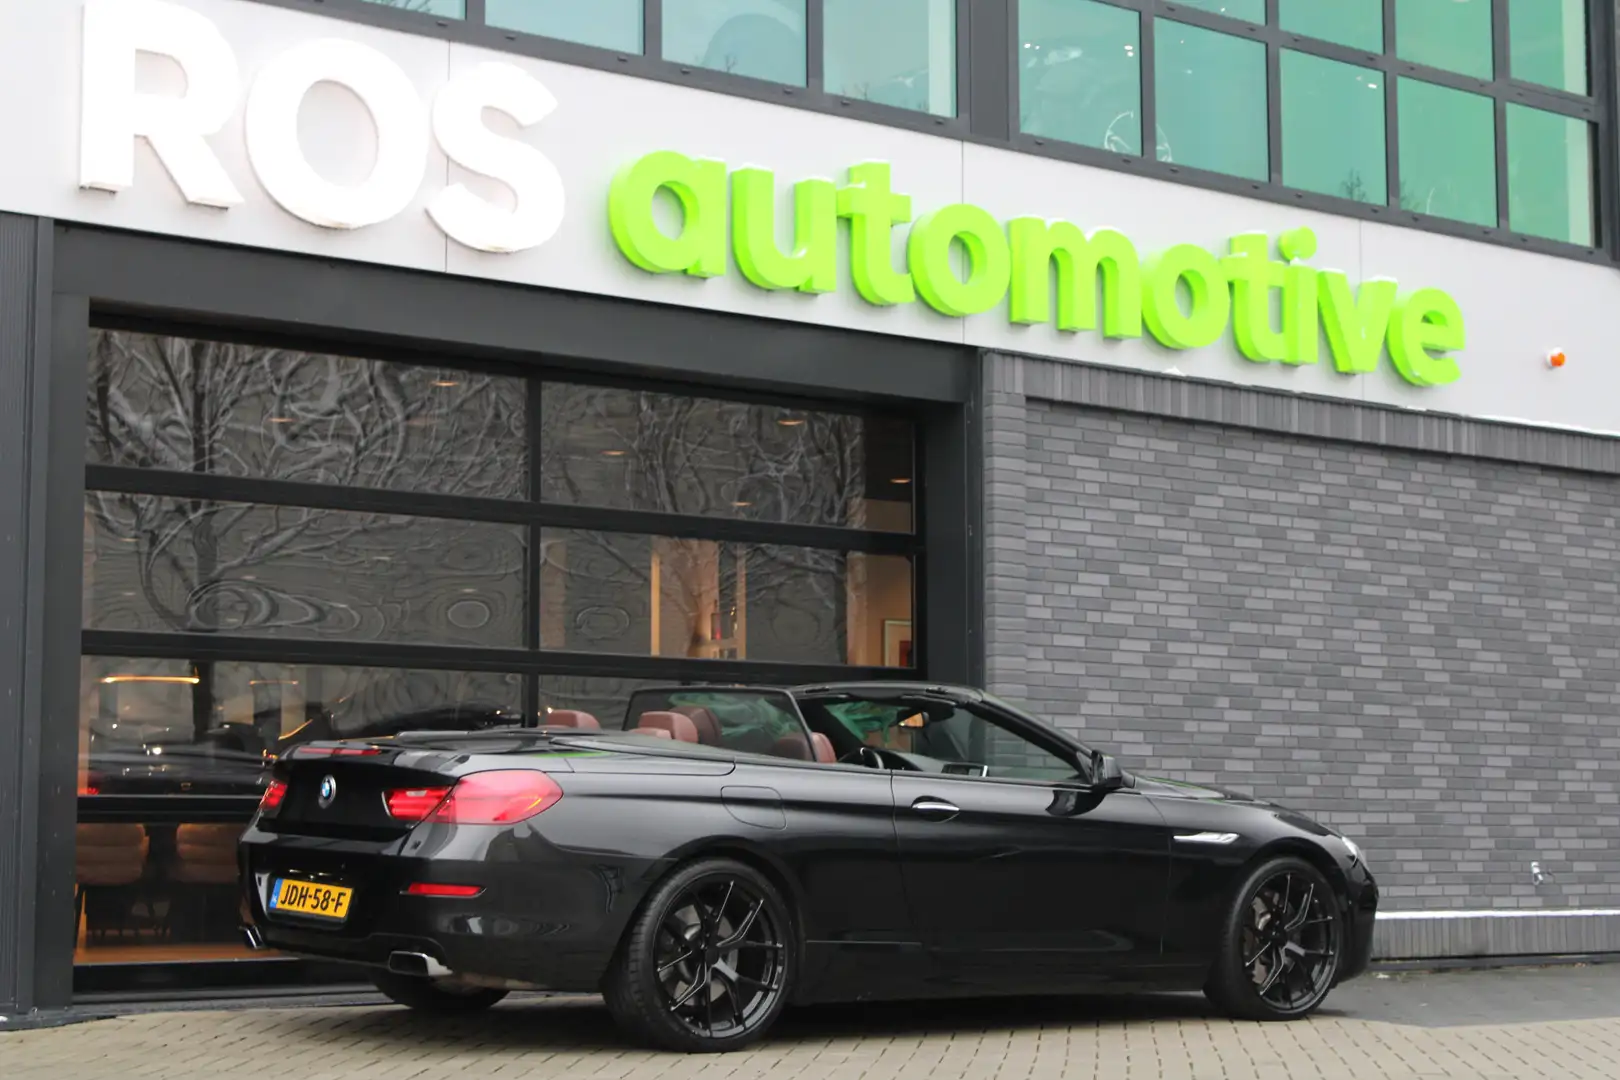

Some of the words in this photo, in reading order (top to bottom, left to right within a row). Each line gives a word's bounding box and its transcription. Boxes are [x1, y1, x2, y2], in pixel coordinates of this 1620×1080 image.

[79, 0, 566, 254] ROS
[608, 150, 1466, 388] automotive
[280, 884, 346, 913] JDH-58-F
